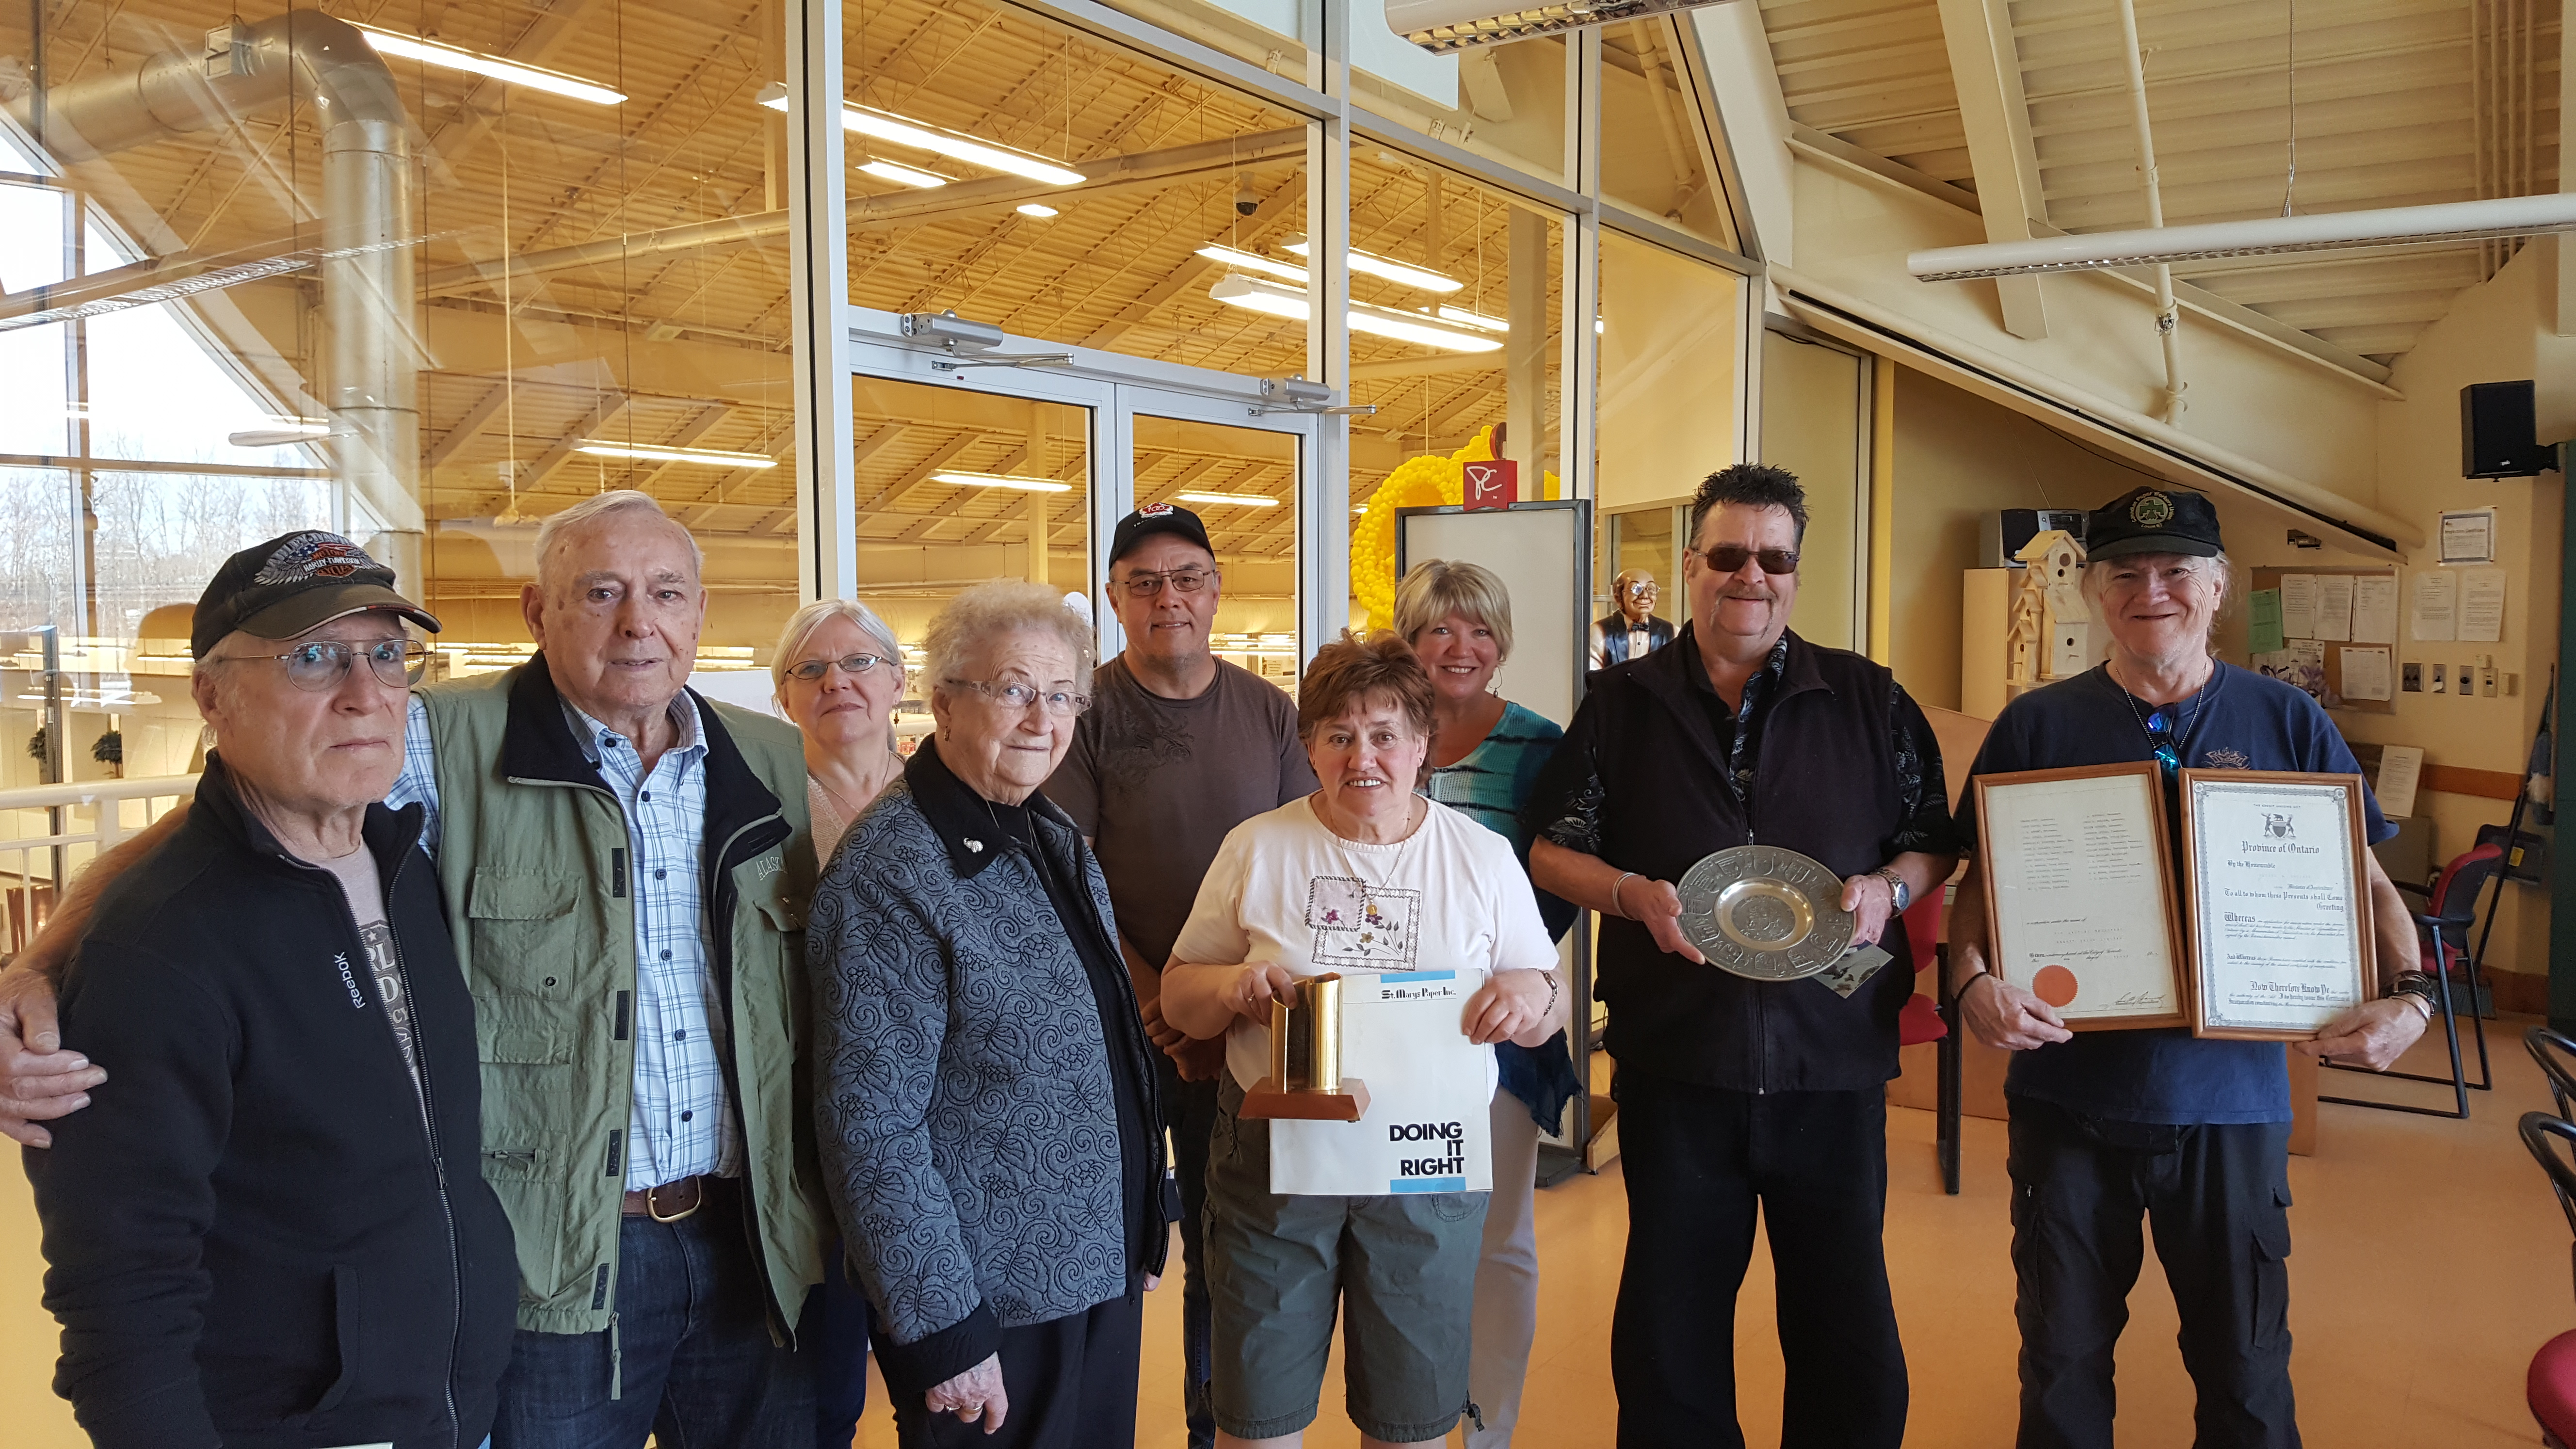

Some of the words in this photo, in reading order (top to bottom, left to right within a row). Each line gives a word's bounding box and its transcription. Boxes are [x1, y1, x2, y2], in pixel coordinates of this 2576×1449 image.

[302, 557, 361, 573] HARLEY-DAVIDSON
[2242, 841, 2276, 853] Province
[2278, 843, 2286, 853] of
[2288, 843, 2319, 854] Ontario
[2224, 888, 2233, 896] To
[2283, 891, 2309, 900] Presents
[2317, 902, 2344, 913] Greeting
[2224, 911, 2255, 922] Whereas
[334, 951, 366, 1009] Reebok
[1382, 990, 1396, 999] St.
[1422, 987, 1443, 999] Paper
[1443, 986, 1456, 996] Inc.
[2250, 981, 2268, 991] Now
[2268, 981, 2300, 992] Therefore
[2300, 983, 2320, 993] Know
[1389, 1122, 1463, 1142] DOING
[1447, 1139, 1464, 1156] IT
[1401, 1157, 1465, 1176] RIGHT
